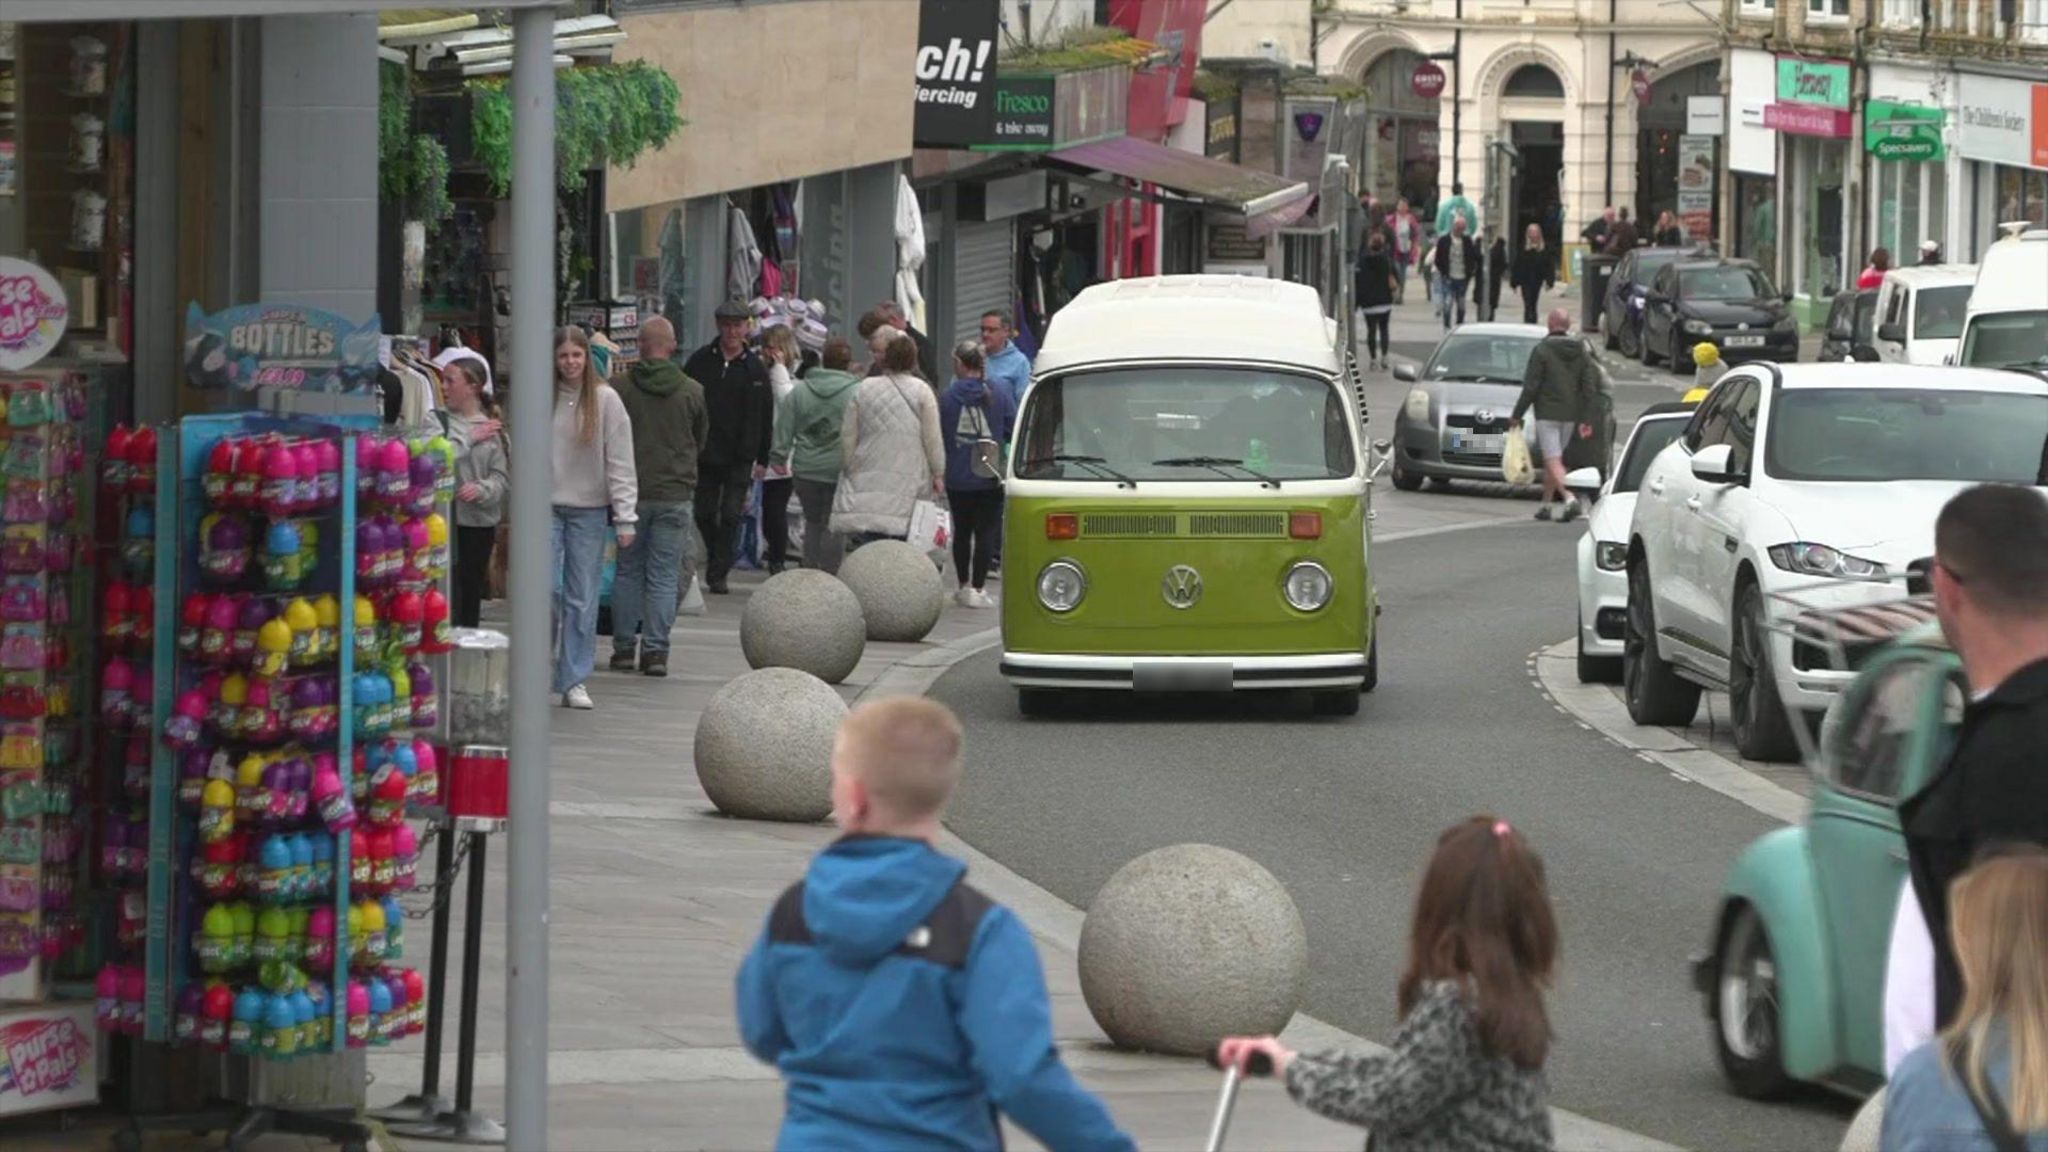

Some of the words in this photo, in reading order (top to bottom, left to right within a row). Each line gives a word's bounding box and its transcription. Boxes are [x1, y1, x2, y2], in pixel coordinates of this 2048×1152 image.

[915, 38, 991, 82] ch!
[1879, 142, 1932, 156] Specsavers
[231, 323, 334, 356] BOTTLES
